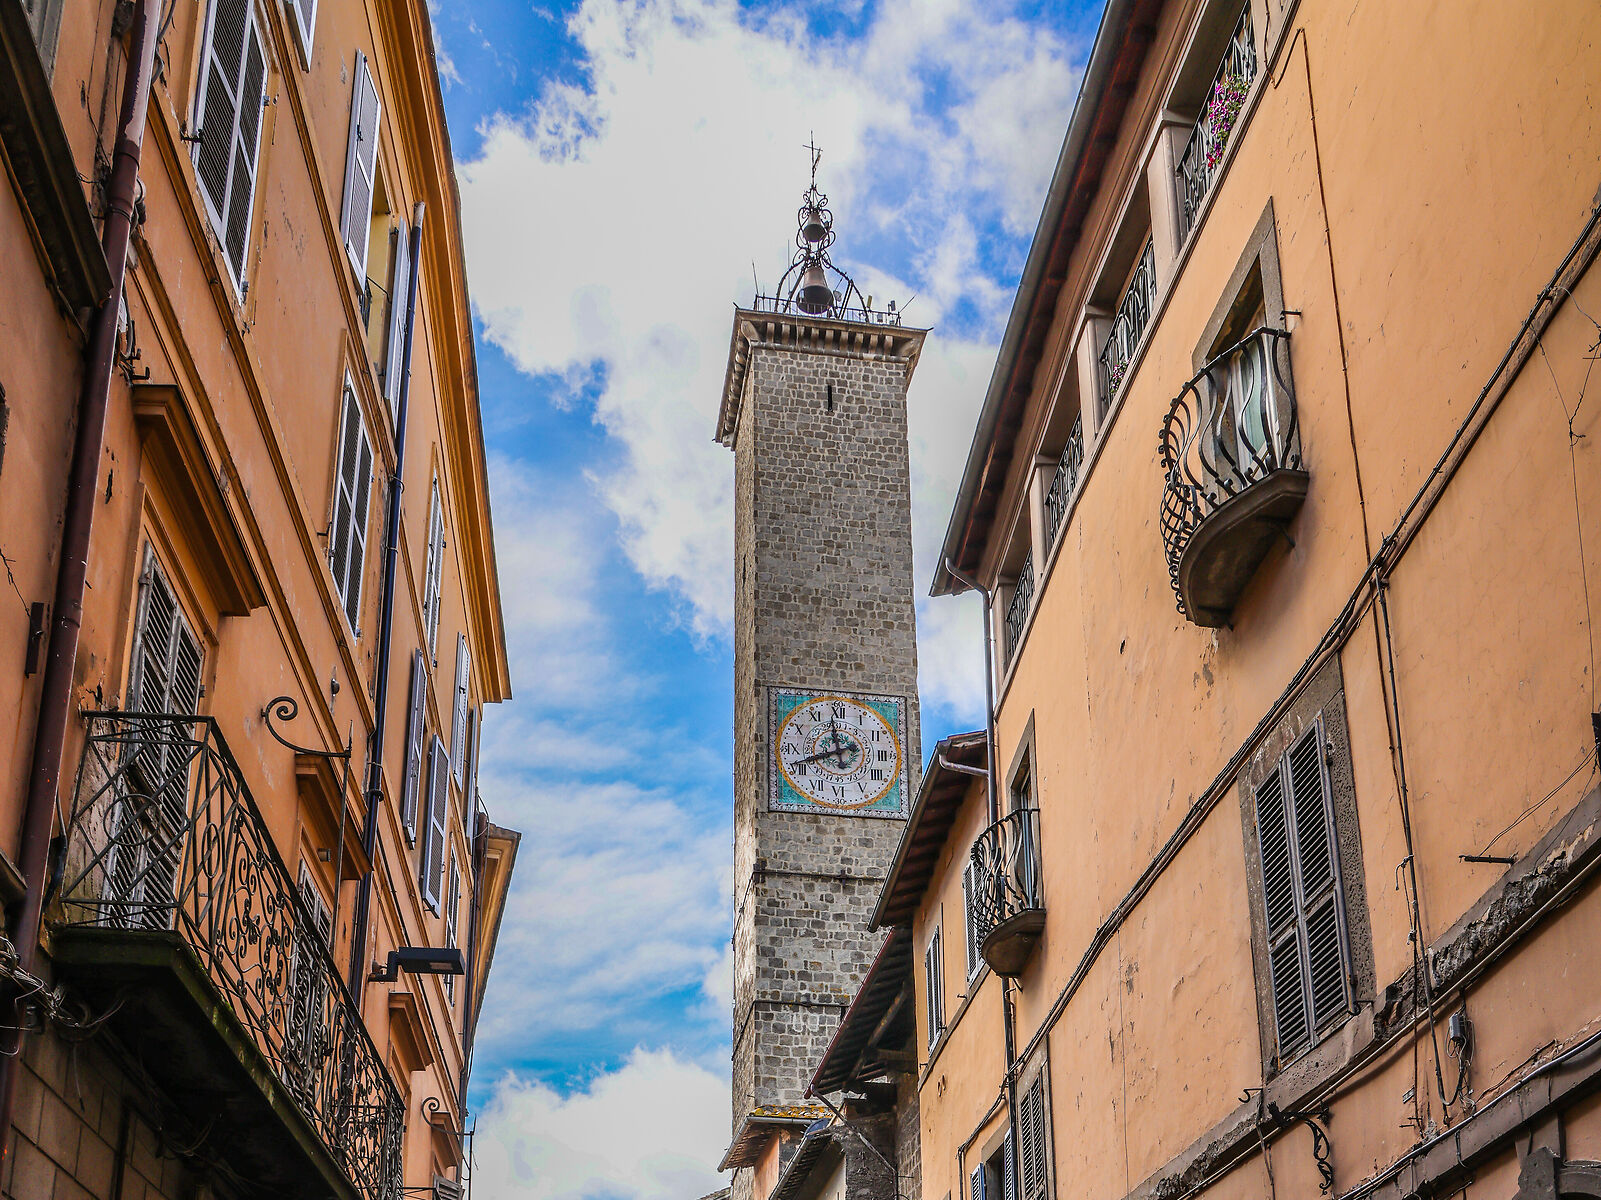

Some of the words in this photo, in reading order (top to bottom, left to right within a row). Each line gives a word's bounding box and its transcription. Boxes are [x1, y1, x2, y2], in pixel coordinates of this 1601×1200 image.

[809, 711, 820, 721] XI
[832, 707, 846, 719] XII
[859, 715, 862, 725] I
[795, 724, 804, 735] X
[872, 730, 879, 741] II
[787, 743, 800, 755] IX
[878, 750, 887, 761] III
[790, 763, 806, 775] VIII
[871, 769, 882, 780] IIII
[809, 780, 823, 791] VII
[858, 782, 867, 793] V
[832, 786, 845, 797] VI
